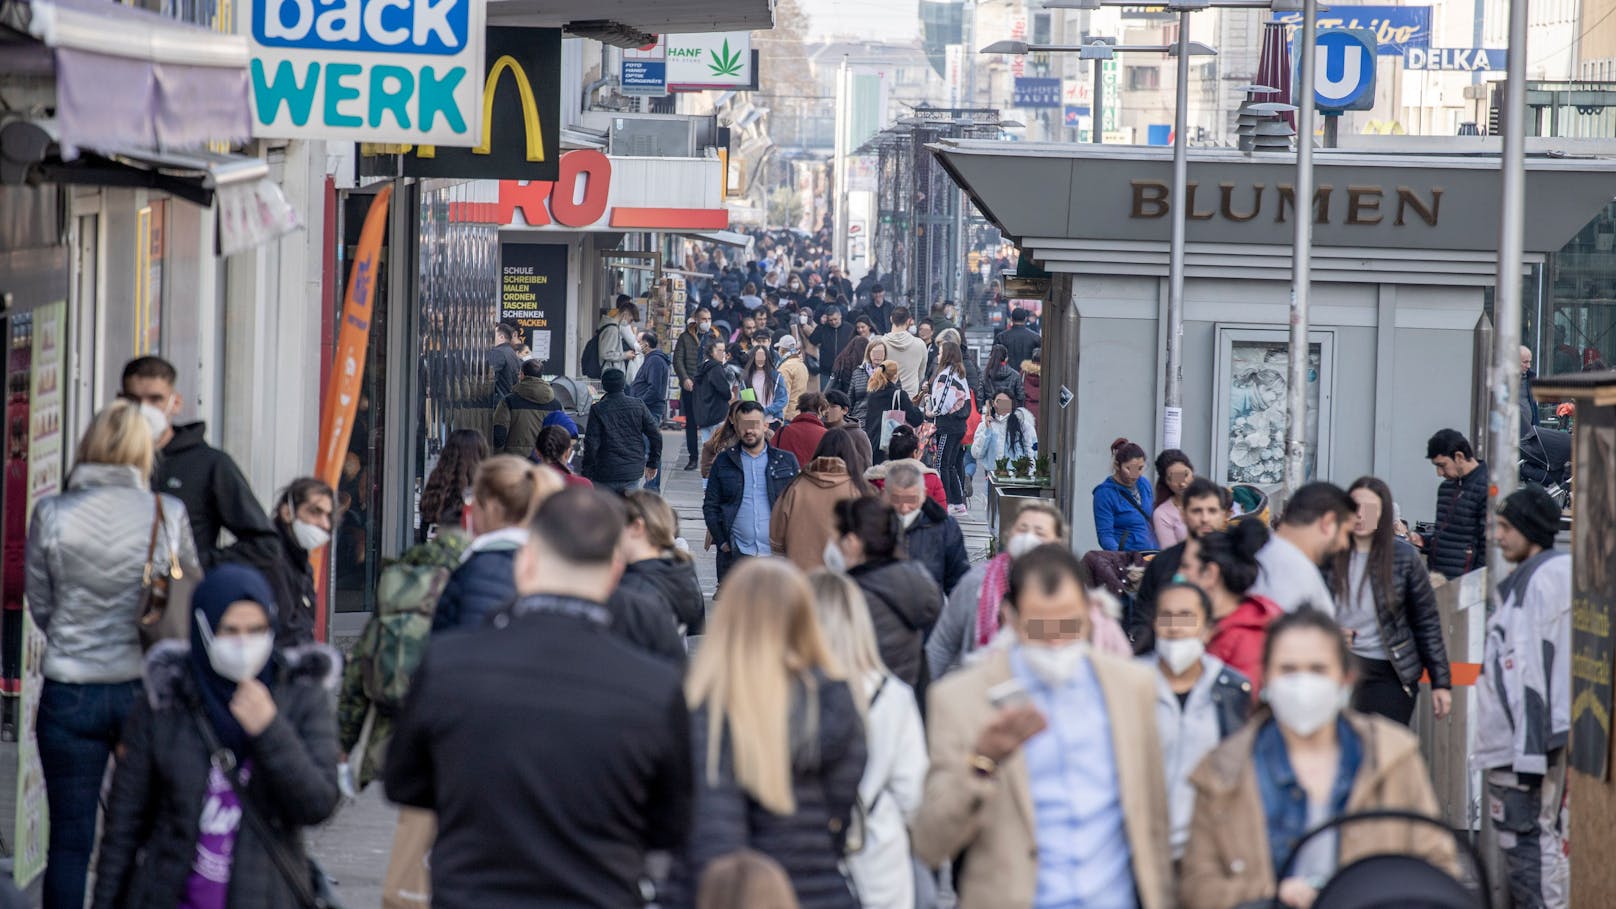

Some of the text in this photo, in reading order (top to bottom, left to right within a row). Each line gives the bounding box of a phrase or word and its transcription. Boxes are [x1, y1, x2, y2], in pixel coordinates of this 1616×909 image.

[264, 0, 459, 47] back
[1316, 18, 1421, 45] Tibo
[668, 48, 702, 57] HANF
[1408, 49, 1491, 70] DELKA
[1313, 45, 1362, 100] U
[251, 58, 468, 134] WERK
[1129, 178, 1444, 227] BLUMEN
[503, 310, 544, 318] SCHENKEN
